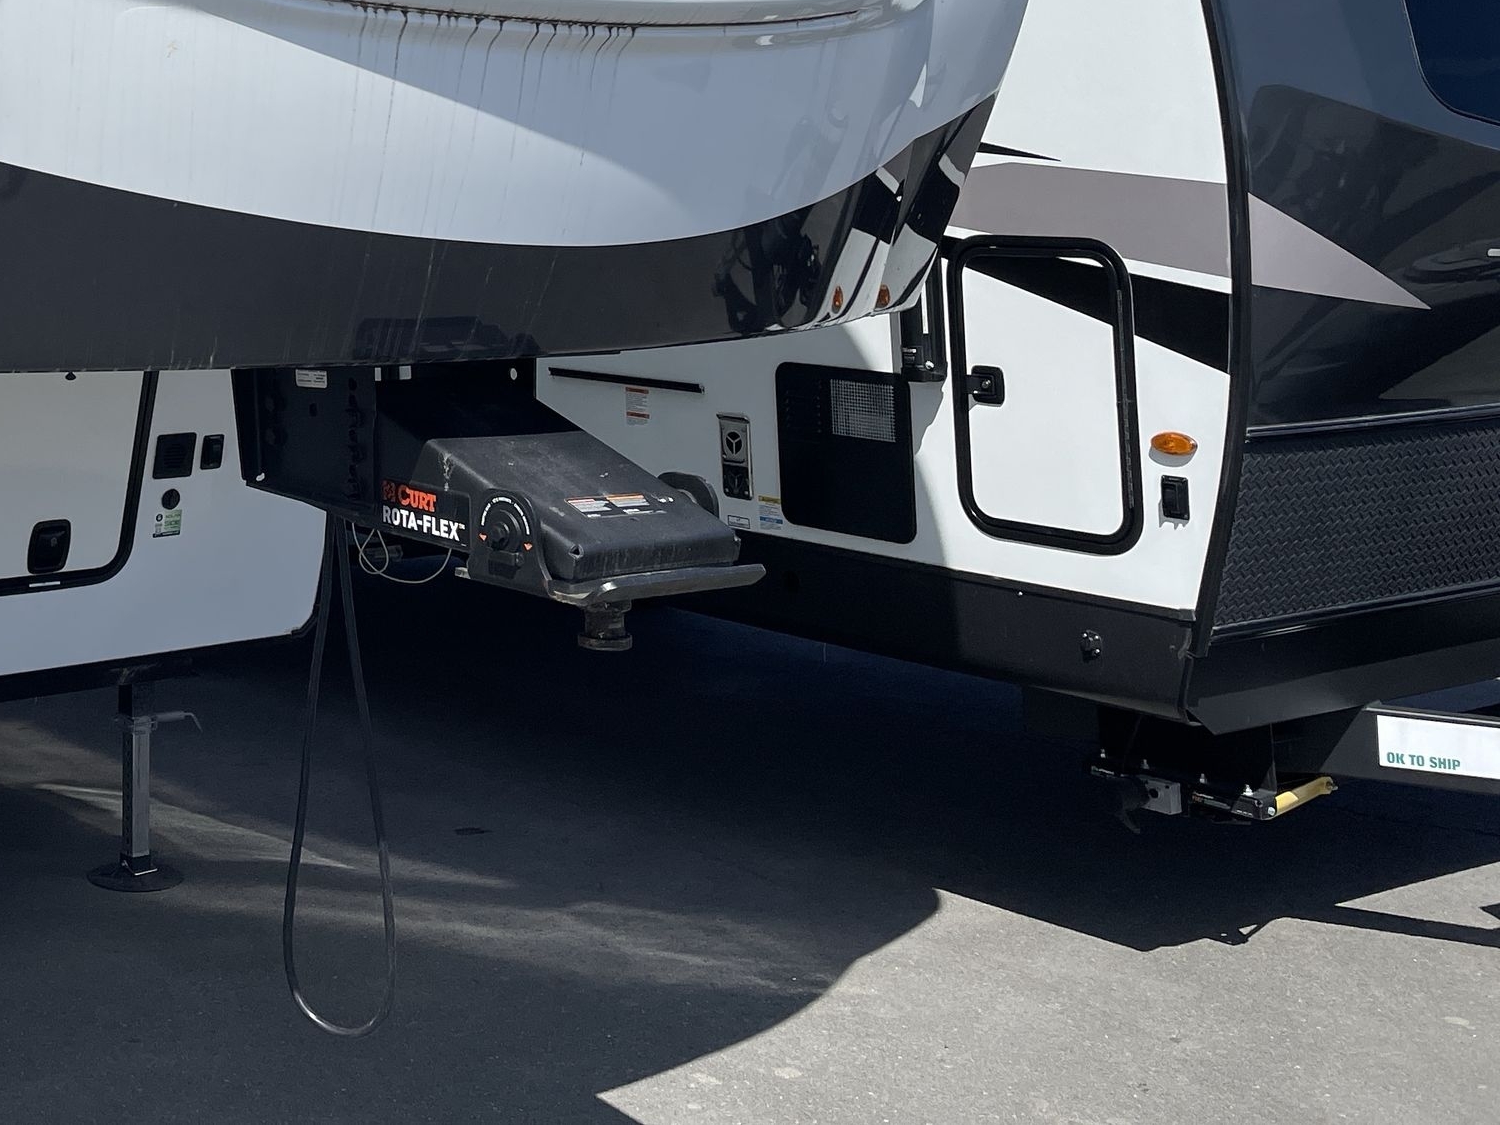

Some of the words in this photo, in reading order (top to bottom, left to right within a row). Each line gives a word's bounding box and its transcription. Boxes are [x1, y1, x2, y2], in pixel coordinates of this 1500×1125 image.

[1386, 752, 1405, 765] OK
[1408, 754, 1425, 767] TO
[1429, 756, 1460, 770] SHIP
